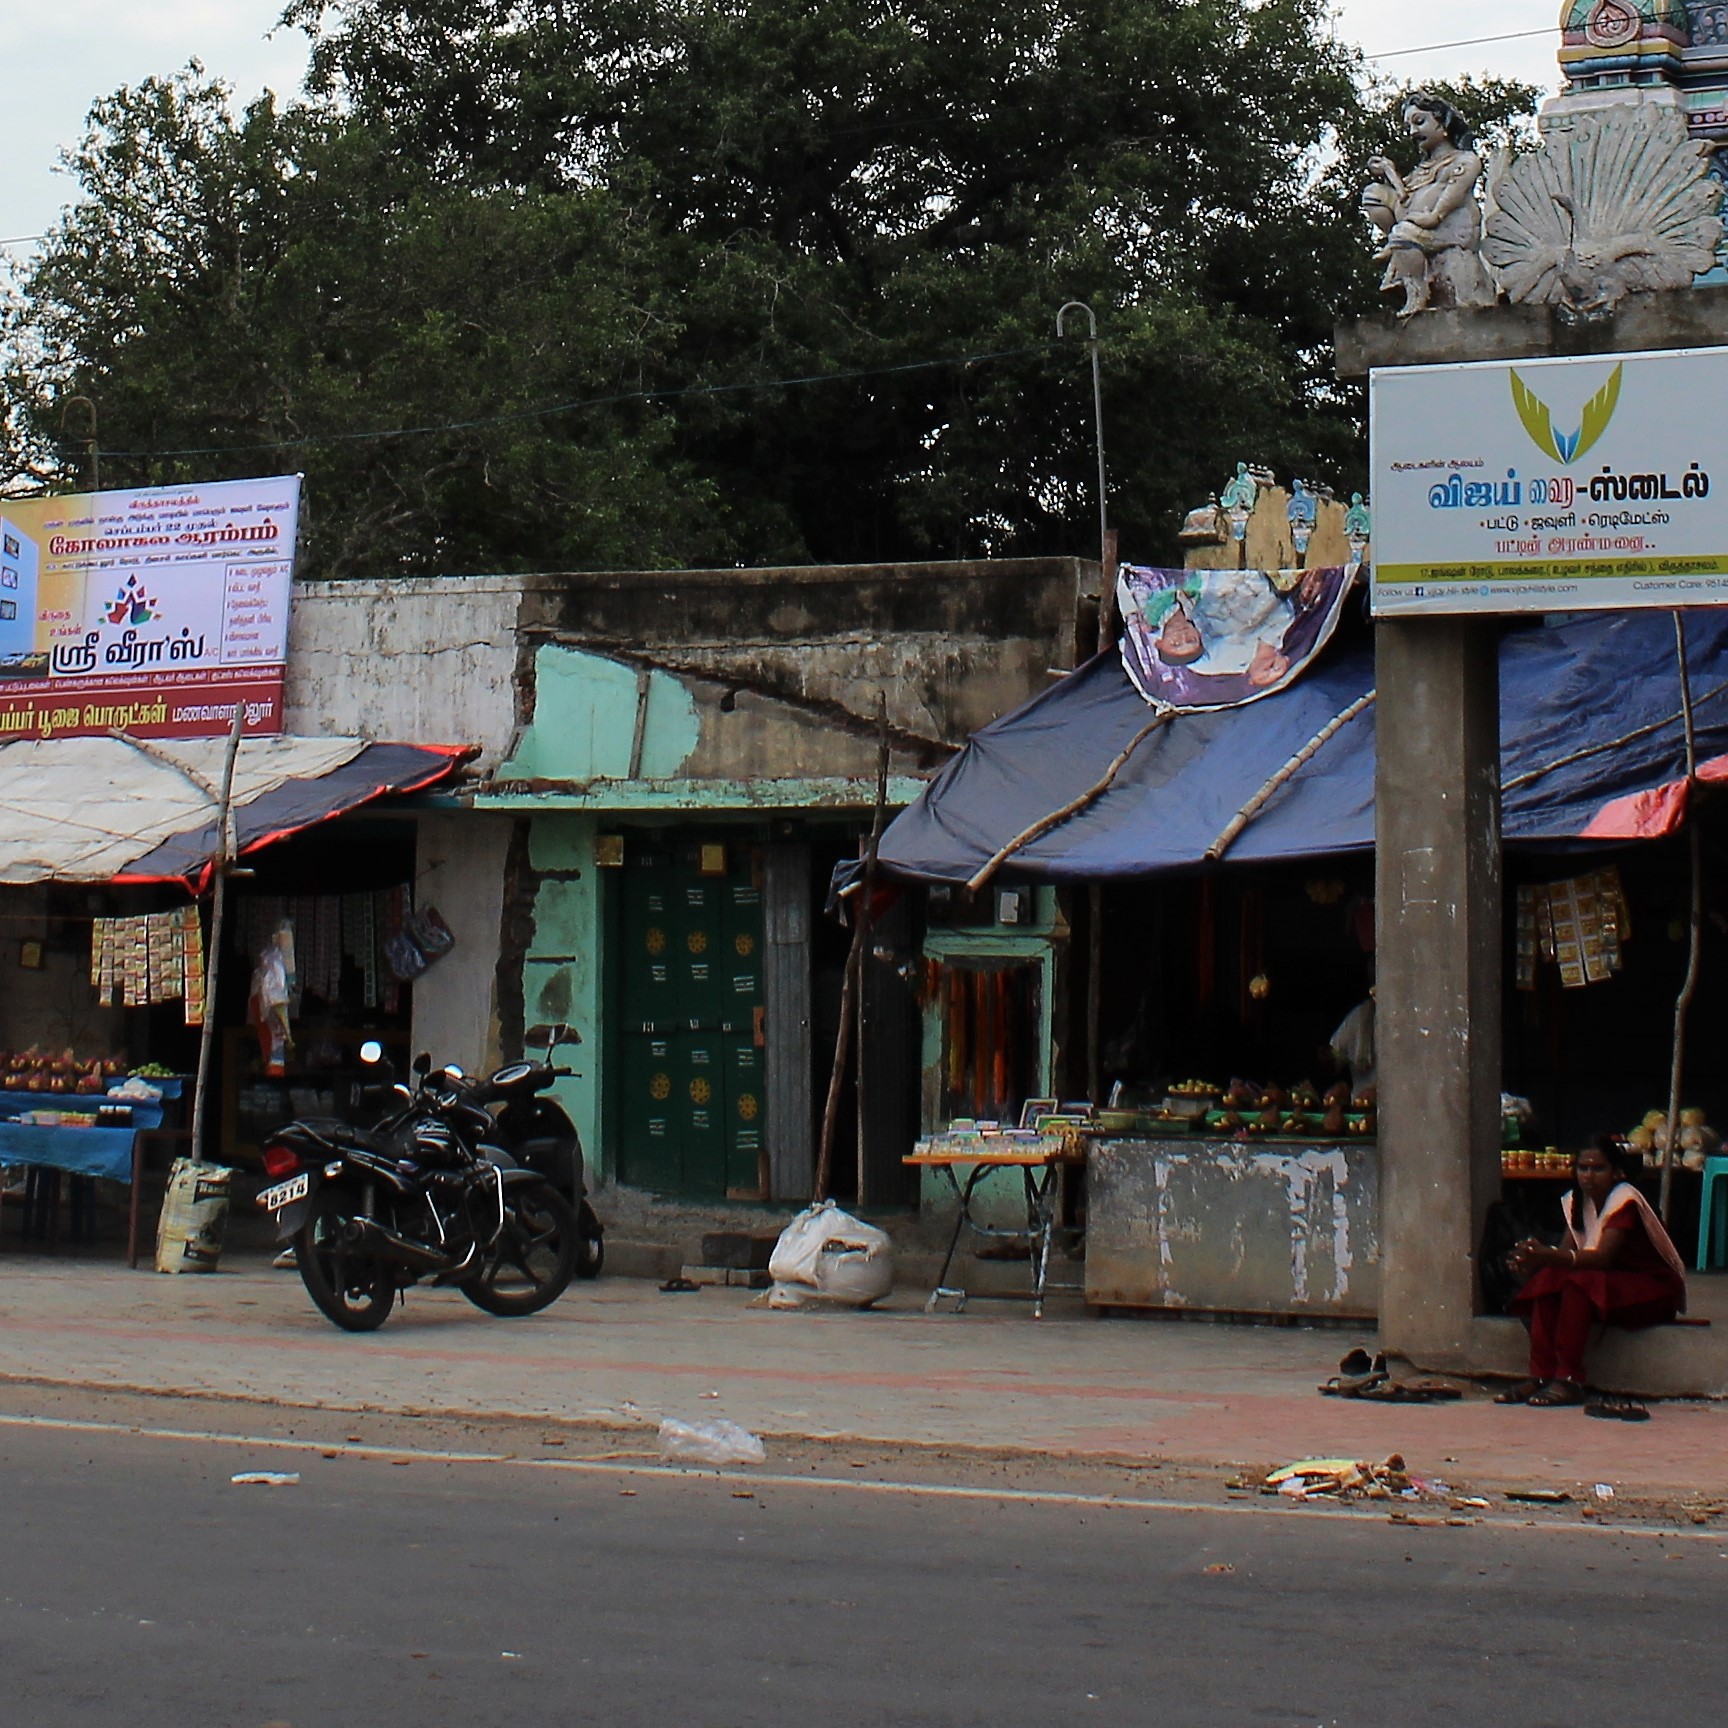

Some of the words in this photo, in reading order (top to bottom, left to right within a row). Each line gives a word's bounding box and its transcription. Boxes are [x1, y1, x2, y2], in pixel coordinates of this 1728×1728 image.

[1429, 468, 1521, 508] விஜய்
[38, 706, 80, 738] பூஜை
[84, 694, 168, 732] பொருட்கள்
